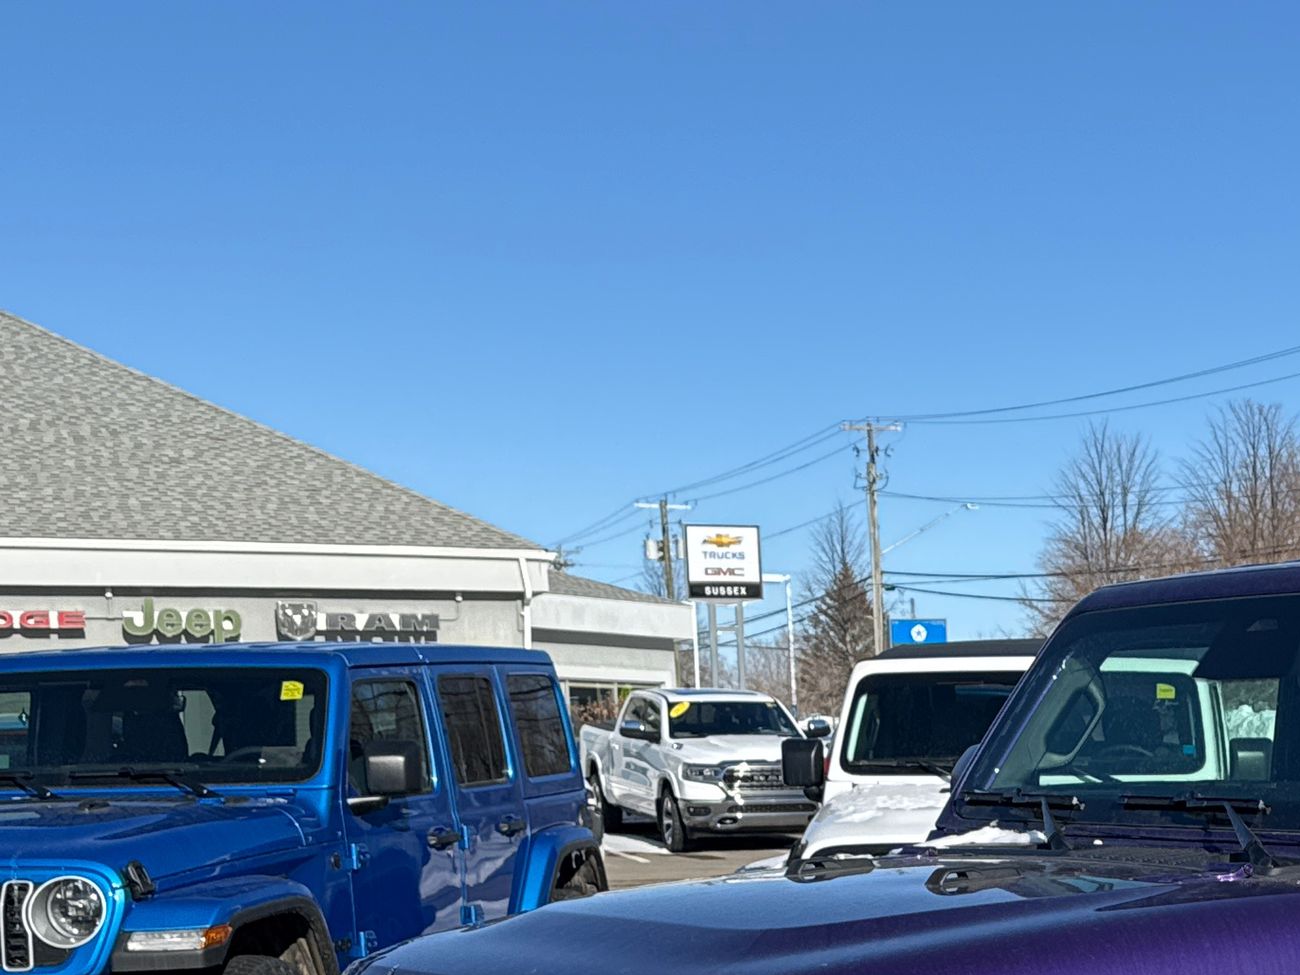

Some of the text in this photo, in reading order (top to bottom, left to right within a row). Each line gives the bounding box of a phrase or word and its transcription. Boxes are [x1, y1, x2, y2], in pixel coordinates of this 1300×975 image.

[702, 551, 746, 560] TRUCKS
[705, 567, 745, 577] GMC
[704, 586, 747, 596] SUSSEX
[122, 596, 242, 643] Jeep
[326, 613, 440, 631] RAM
